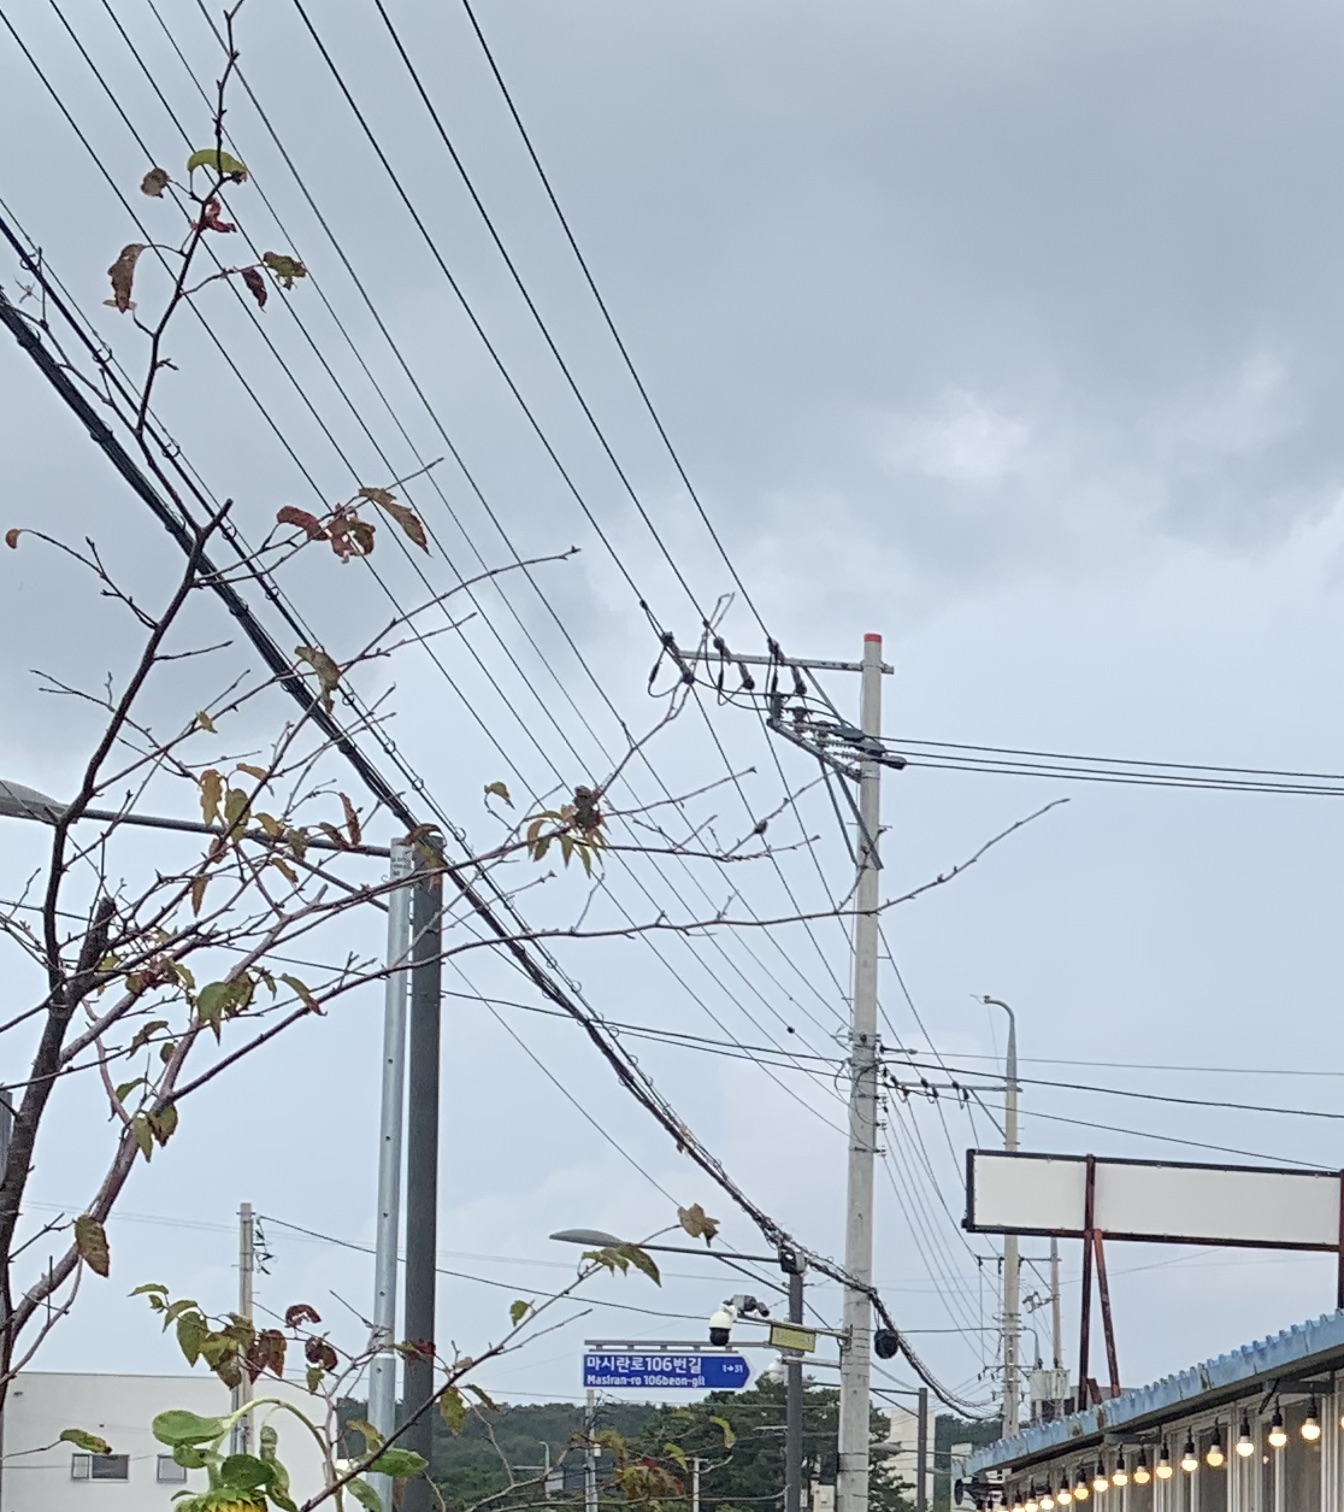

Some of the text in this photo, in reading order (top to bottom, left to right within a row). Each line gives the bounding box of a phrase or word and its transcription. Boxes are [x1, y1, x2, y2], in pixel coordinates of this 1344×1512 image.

[586, 1356, 702, 1374] 마시란로106번길
[586, 1374, 706, 1388] Masiran-ro 106beon-gil
